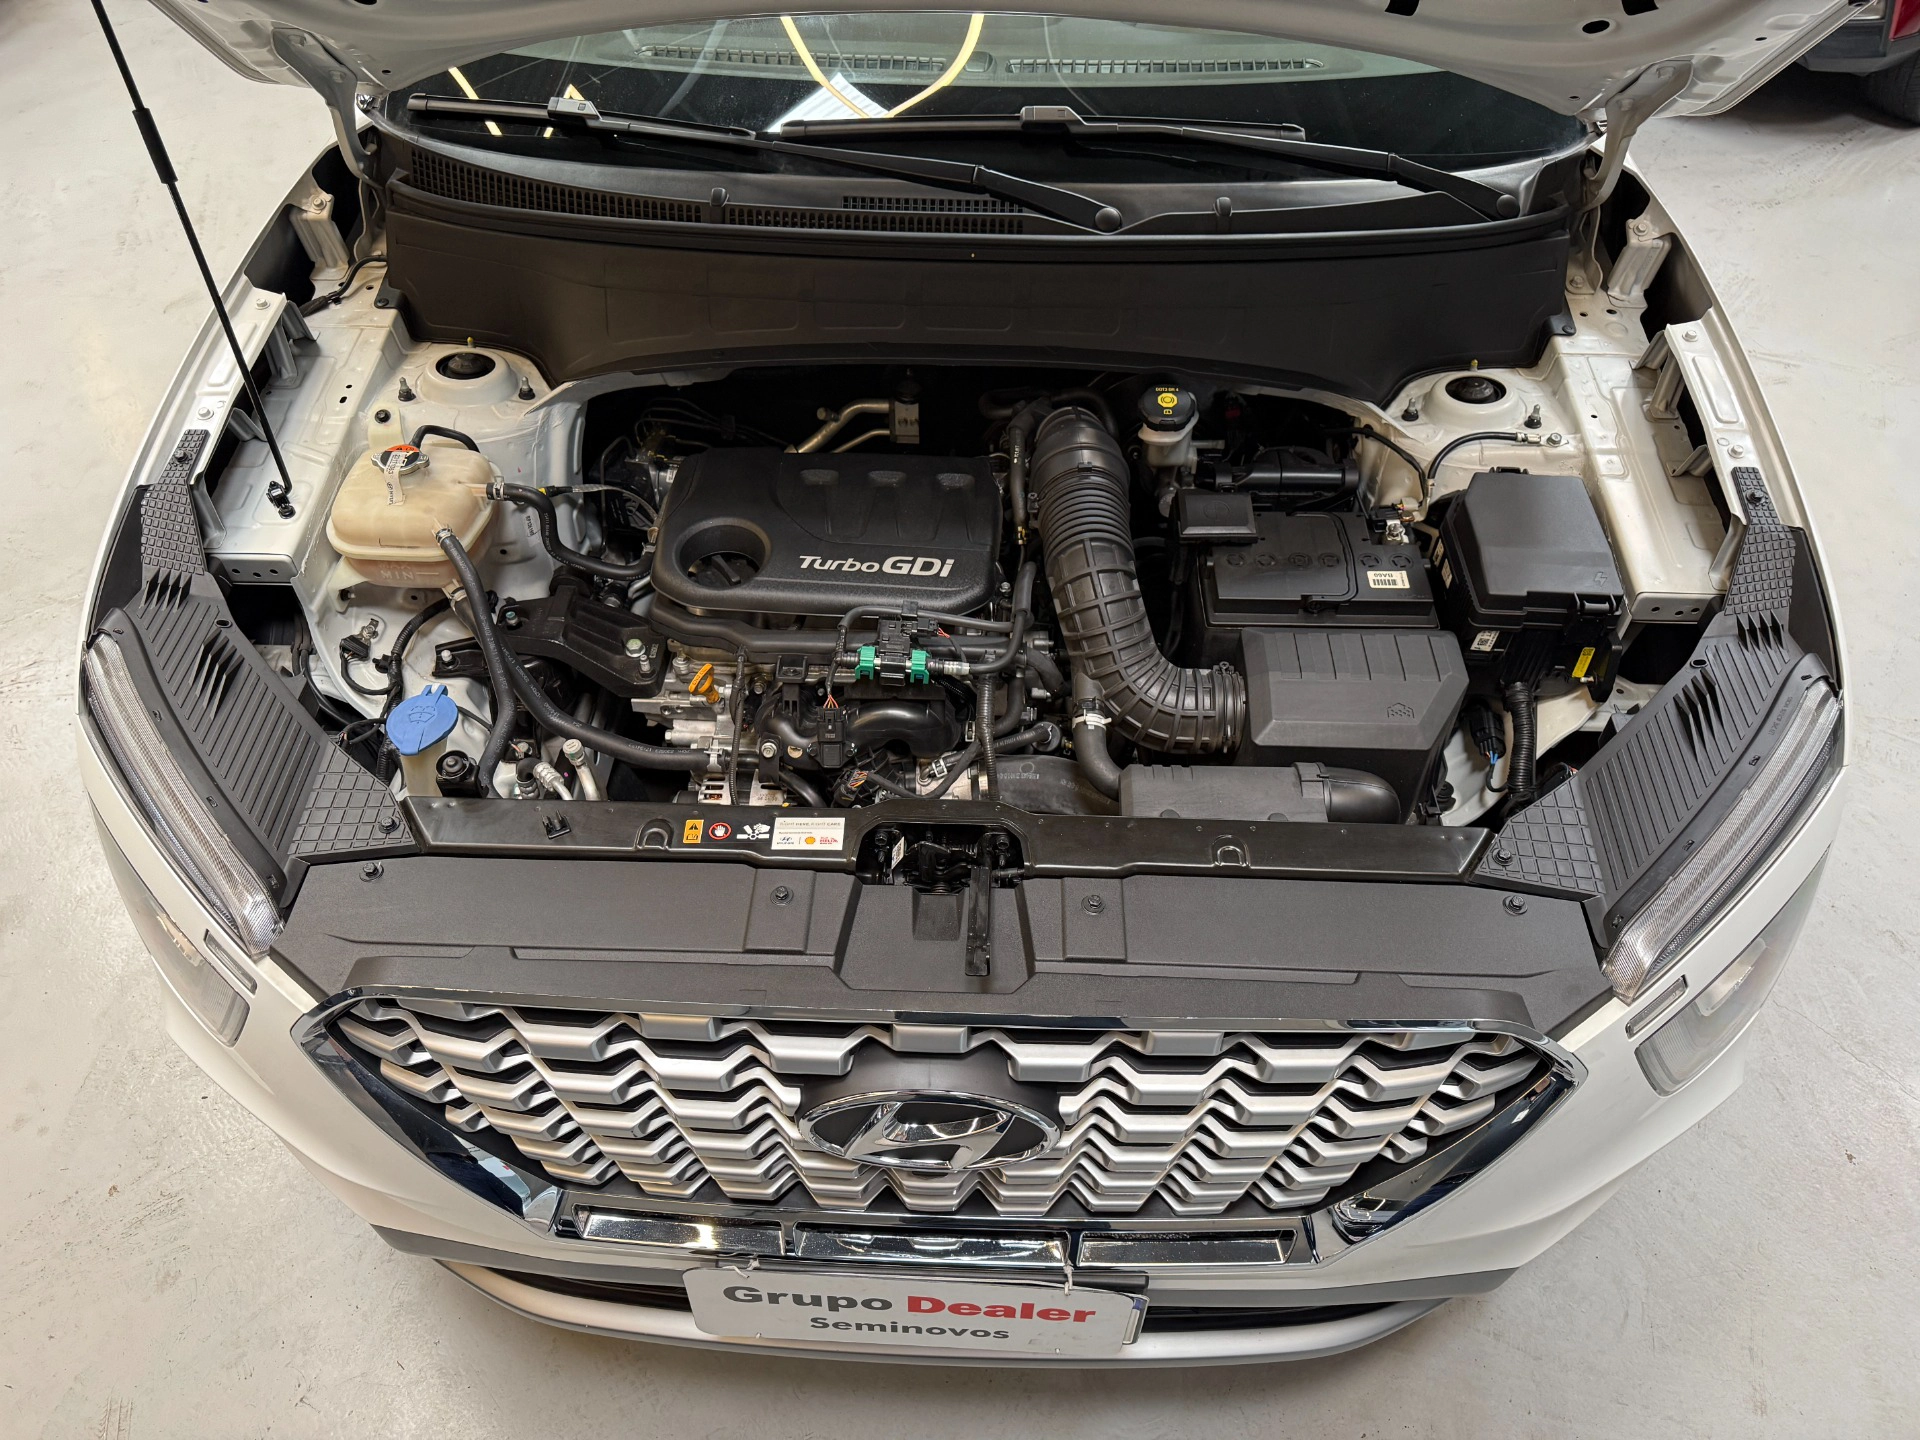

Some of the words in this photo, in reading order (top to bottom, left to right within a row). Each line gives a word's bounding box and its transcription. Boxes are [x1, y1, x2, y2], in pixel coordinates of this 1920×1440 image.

[380, 570, 415, 580] MIN
[722, 1285, 893, 1313] Grupo
[906, 1294, 1097, 1323] Dealer
[810, 1316, 1010, 1340] Seminovos
